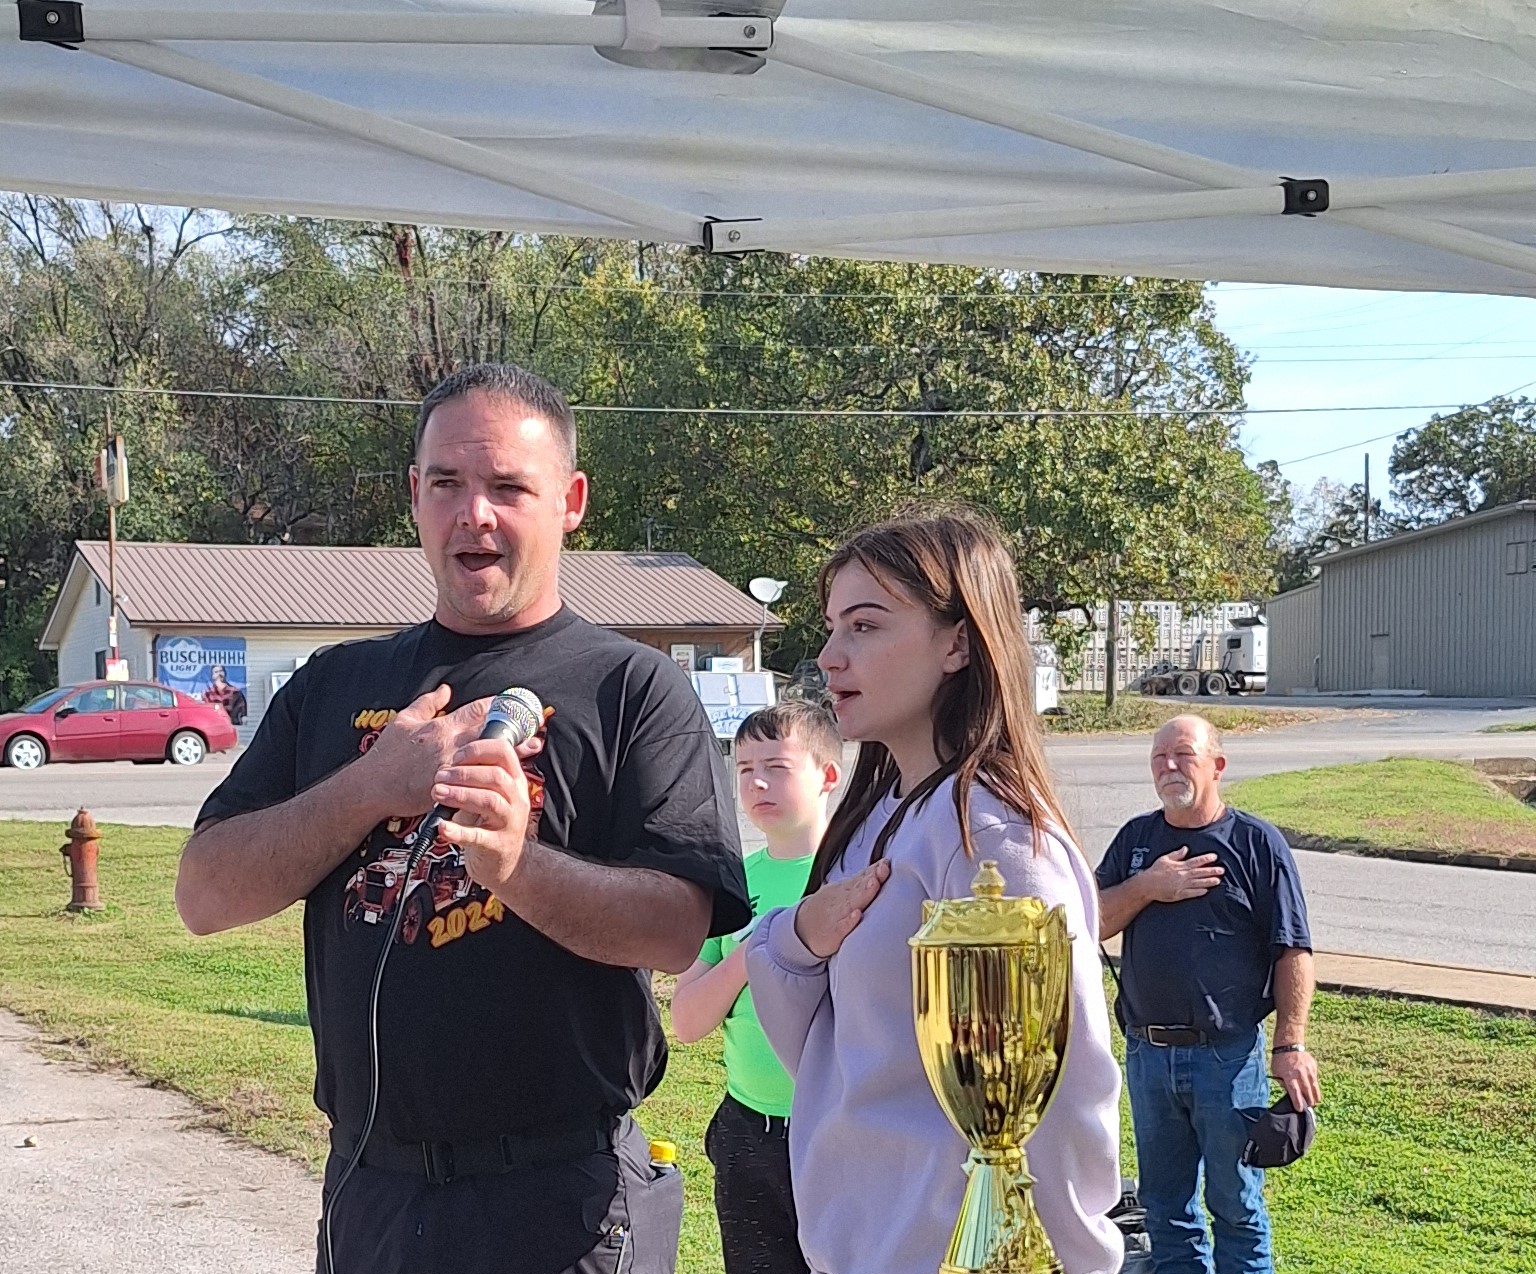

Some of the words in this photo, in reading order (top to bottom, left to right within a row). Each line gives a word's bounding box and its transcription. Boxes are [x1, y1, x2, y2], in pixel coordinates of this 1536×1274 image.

[160, 650, 245, 665] BUSCHHHHH
[170, 664, 197, 672] LIGHT
[427, 894, 505, 948] 2024
